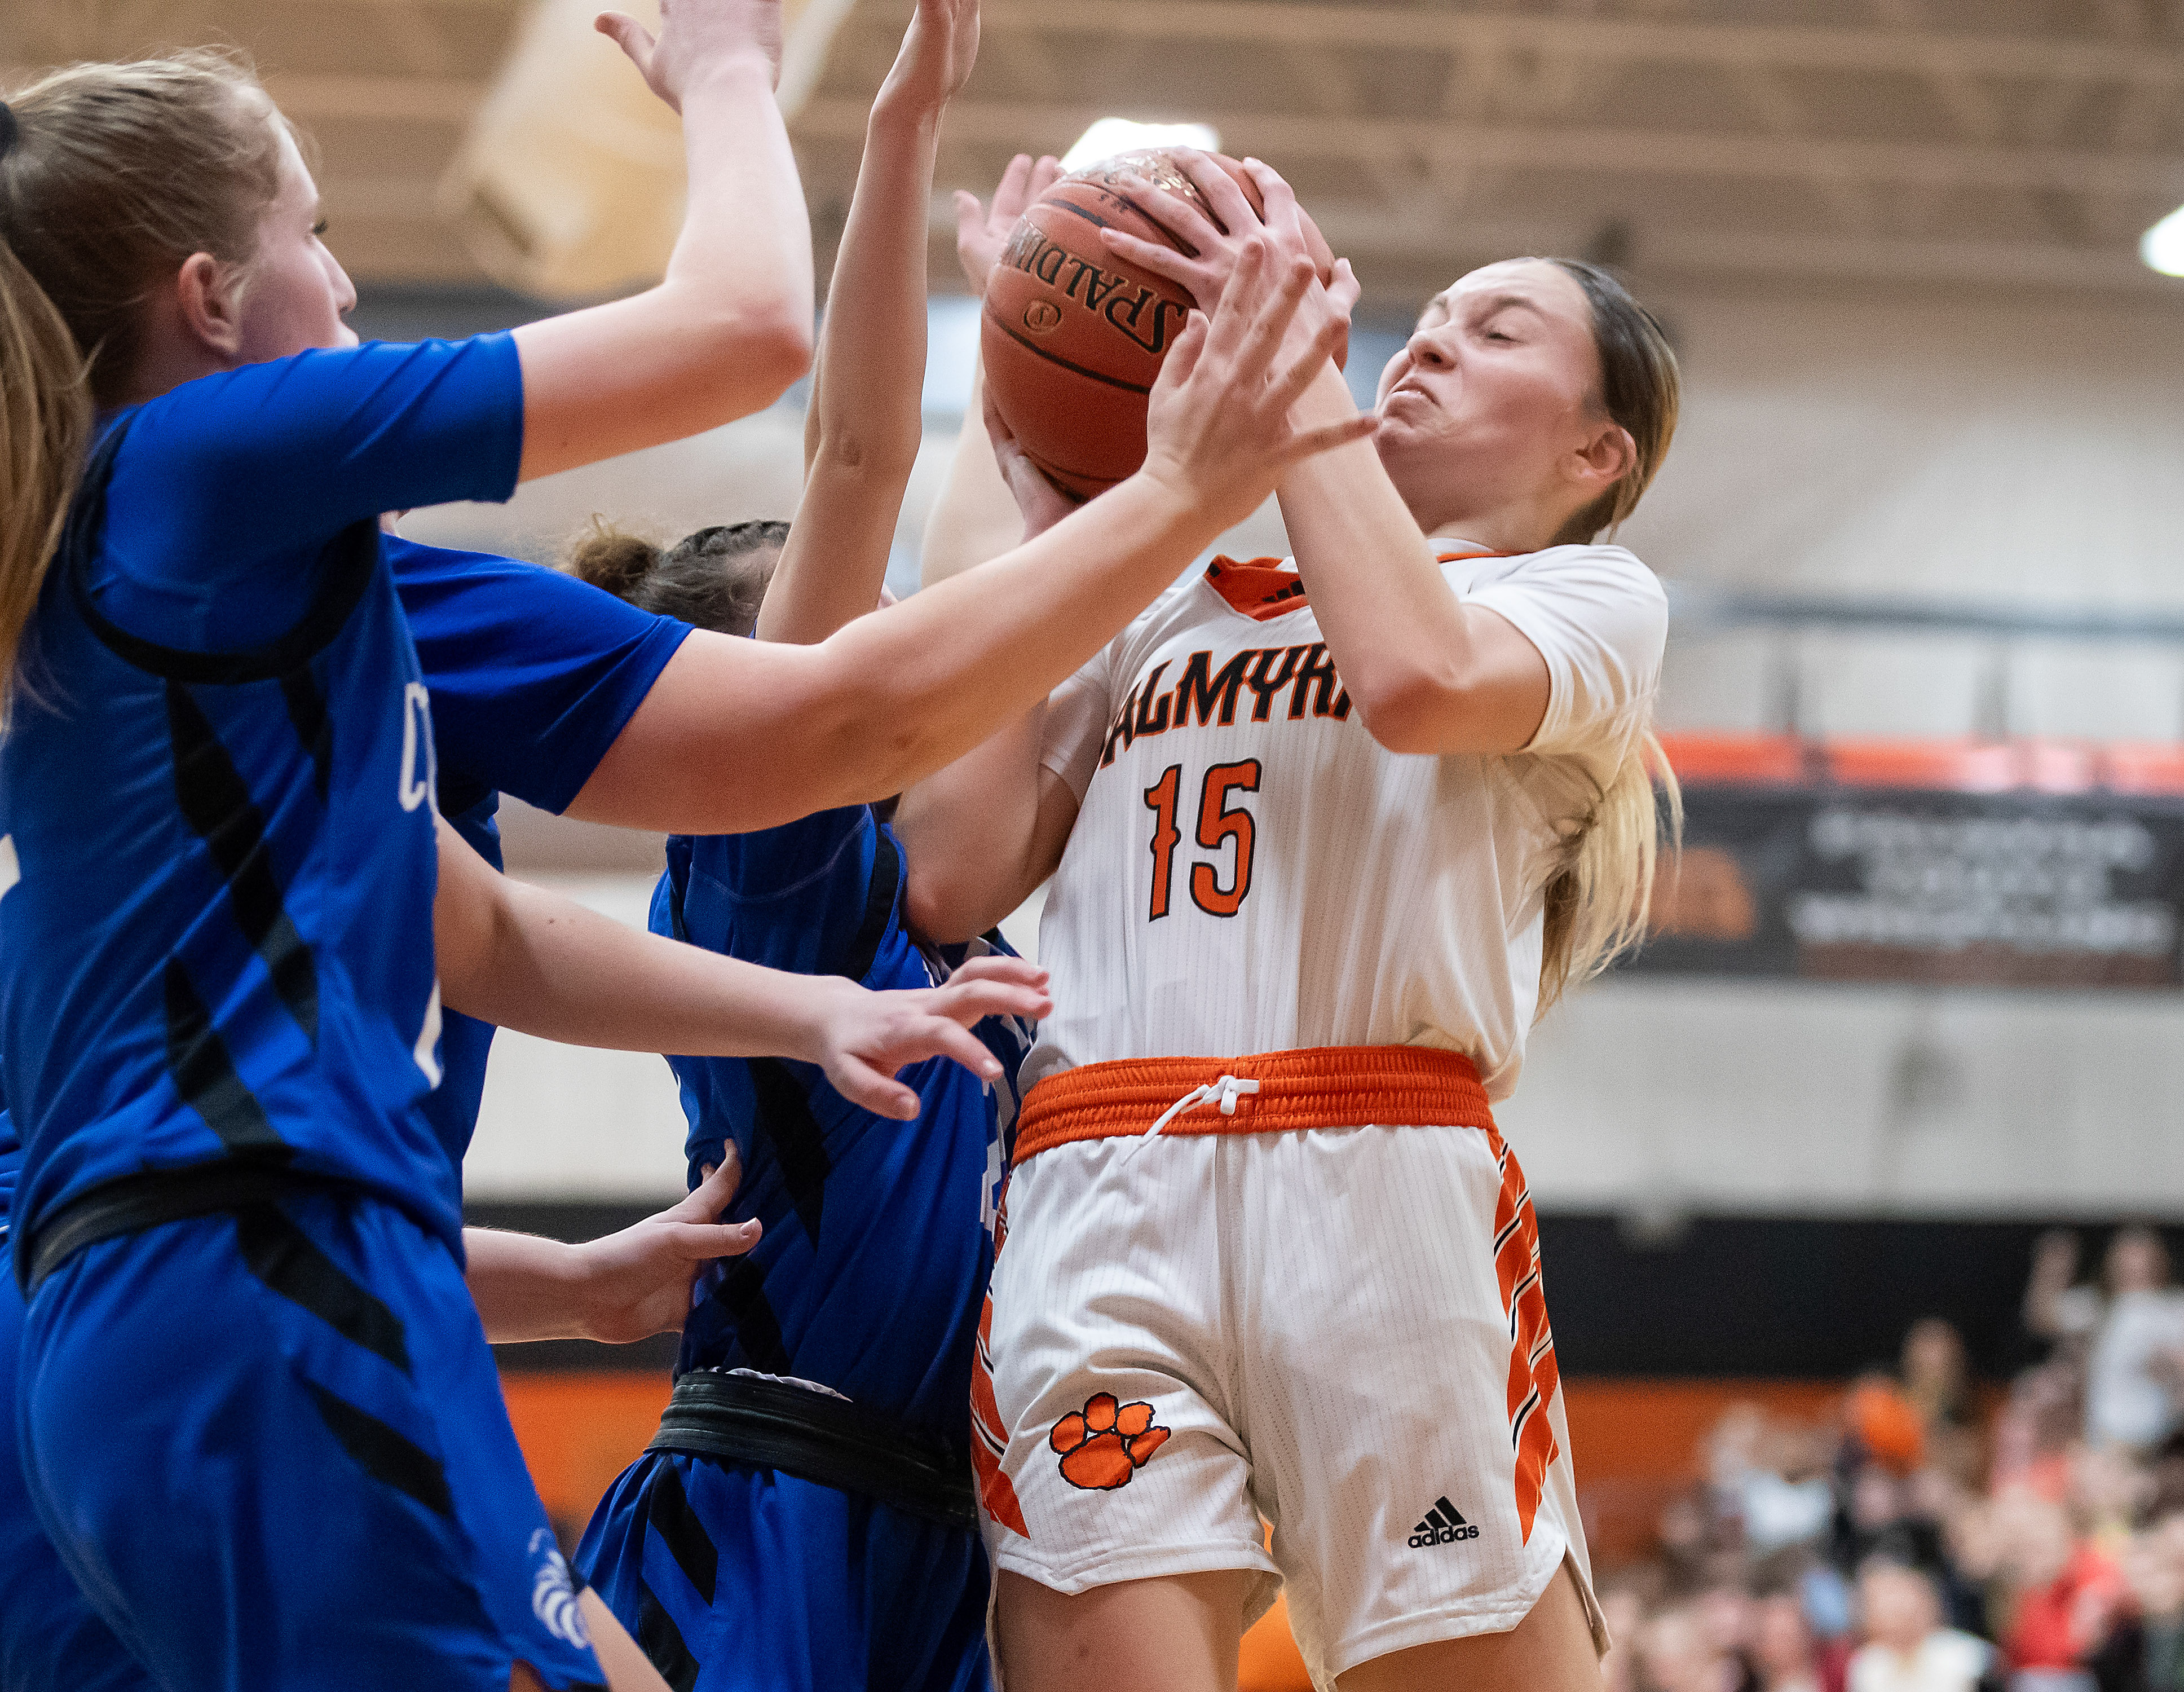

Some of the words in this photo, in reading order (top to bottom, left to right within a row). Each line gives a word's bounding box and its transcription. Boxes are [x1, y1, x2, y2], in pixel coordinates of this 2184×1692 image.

[999, 217, 1186, 354] SPALDI
[1144, 757, 1262, 923] 15
[1408, 1524, 1480, 1548] adidas
